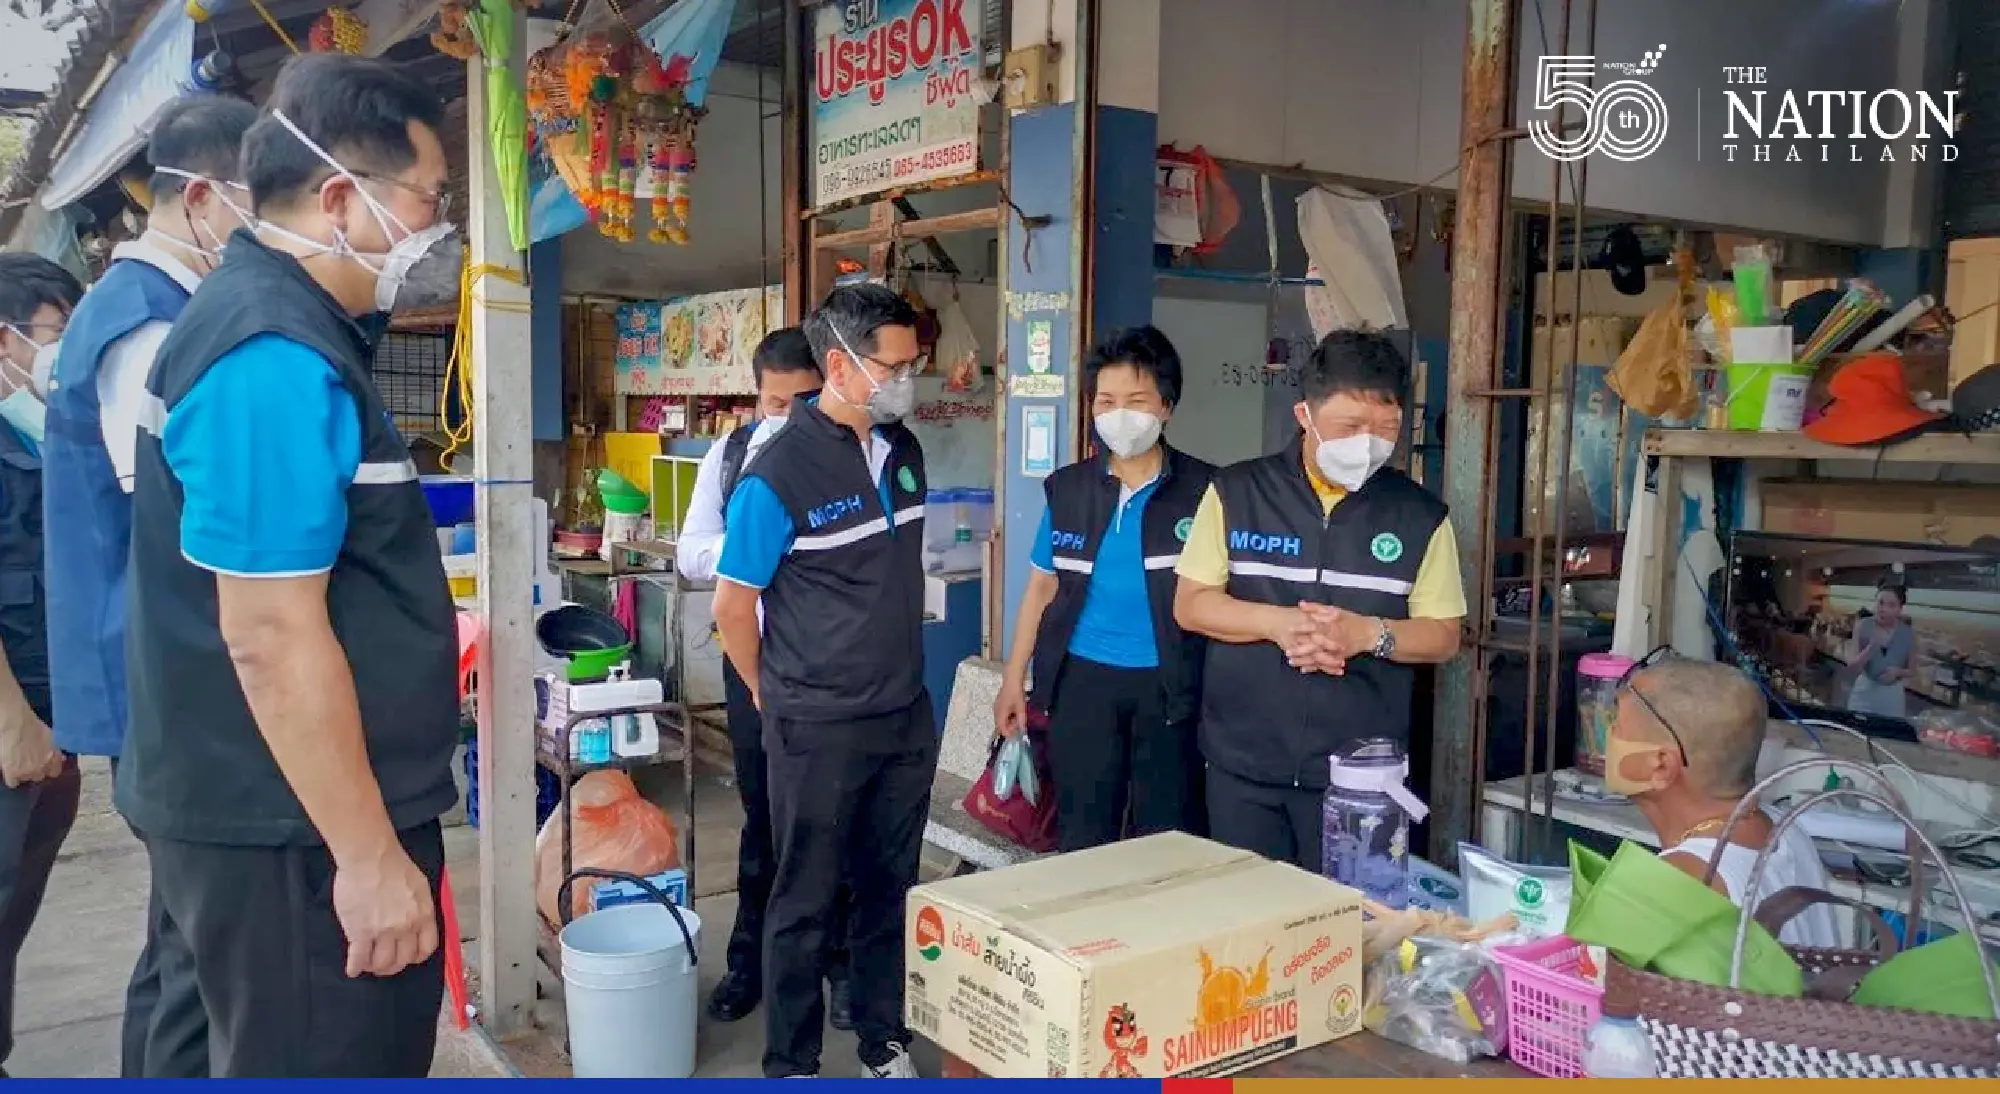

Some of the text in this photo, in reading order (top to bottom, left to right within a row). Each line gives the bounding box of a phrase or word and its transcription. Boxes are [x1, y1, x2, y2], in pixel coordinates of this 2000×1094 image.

[807, 494, 863, 528] MOPH
[1051, 530, 1086, 551] OPH
[1229, 530, 1301, 556] MOPH
[1163, 999, 1298, 1072] SAINUMPUENG
